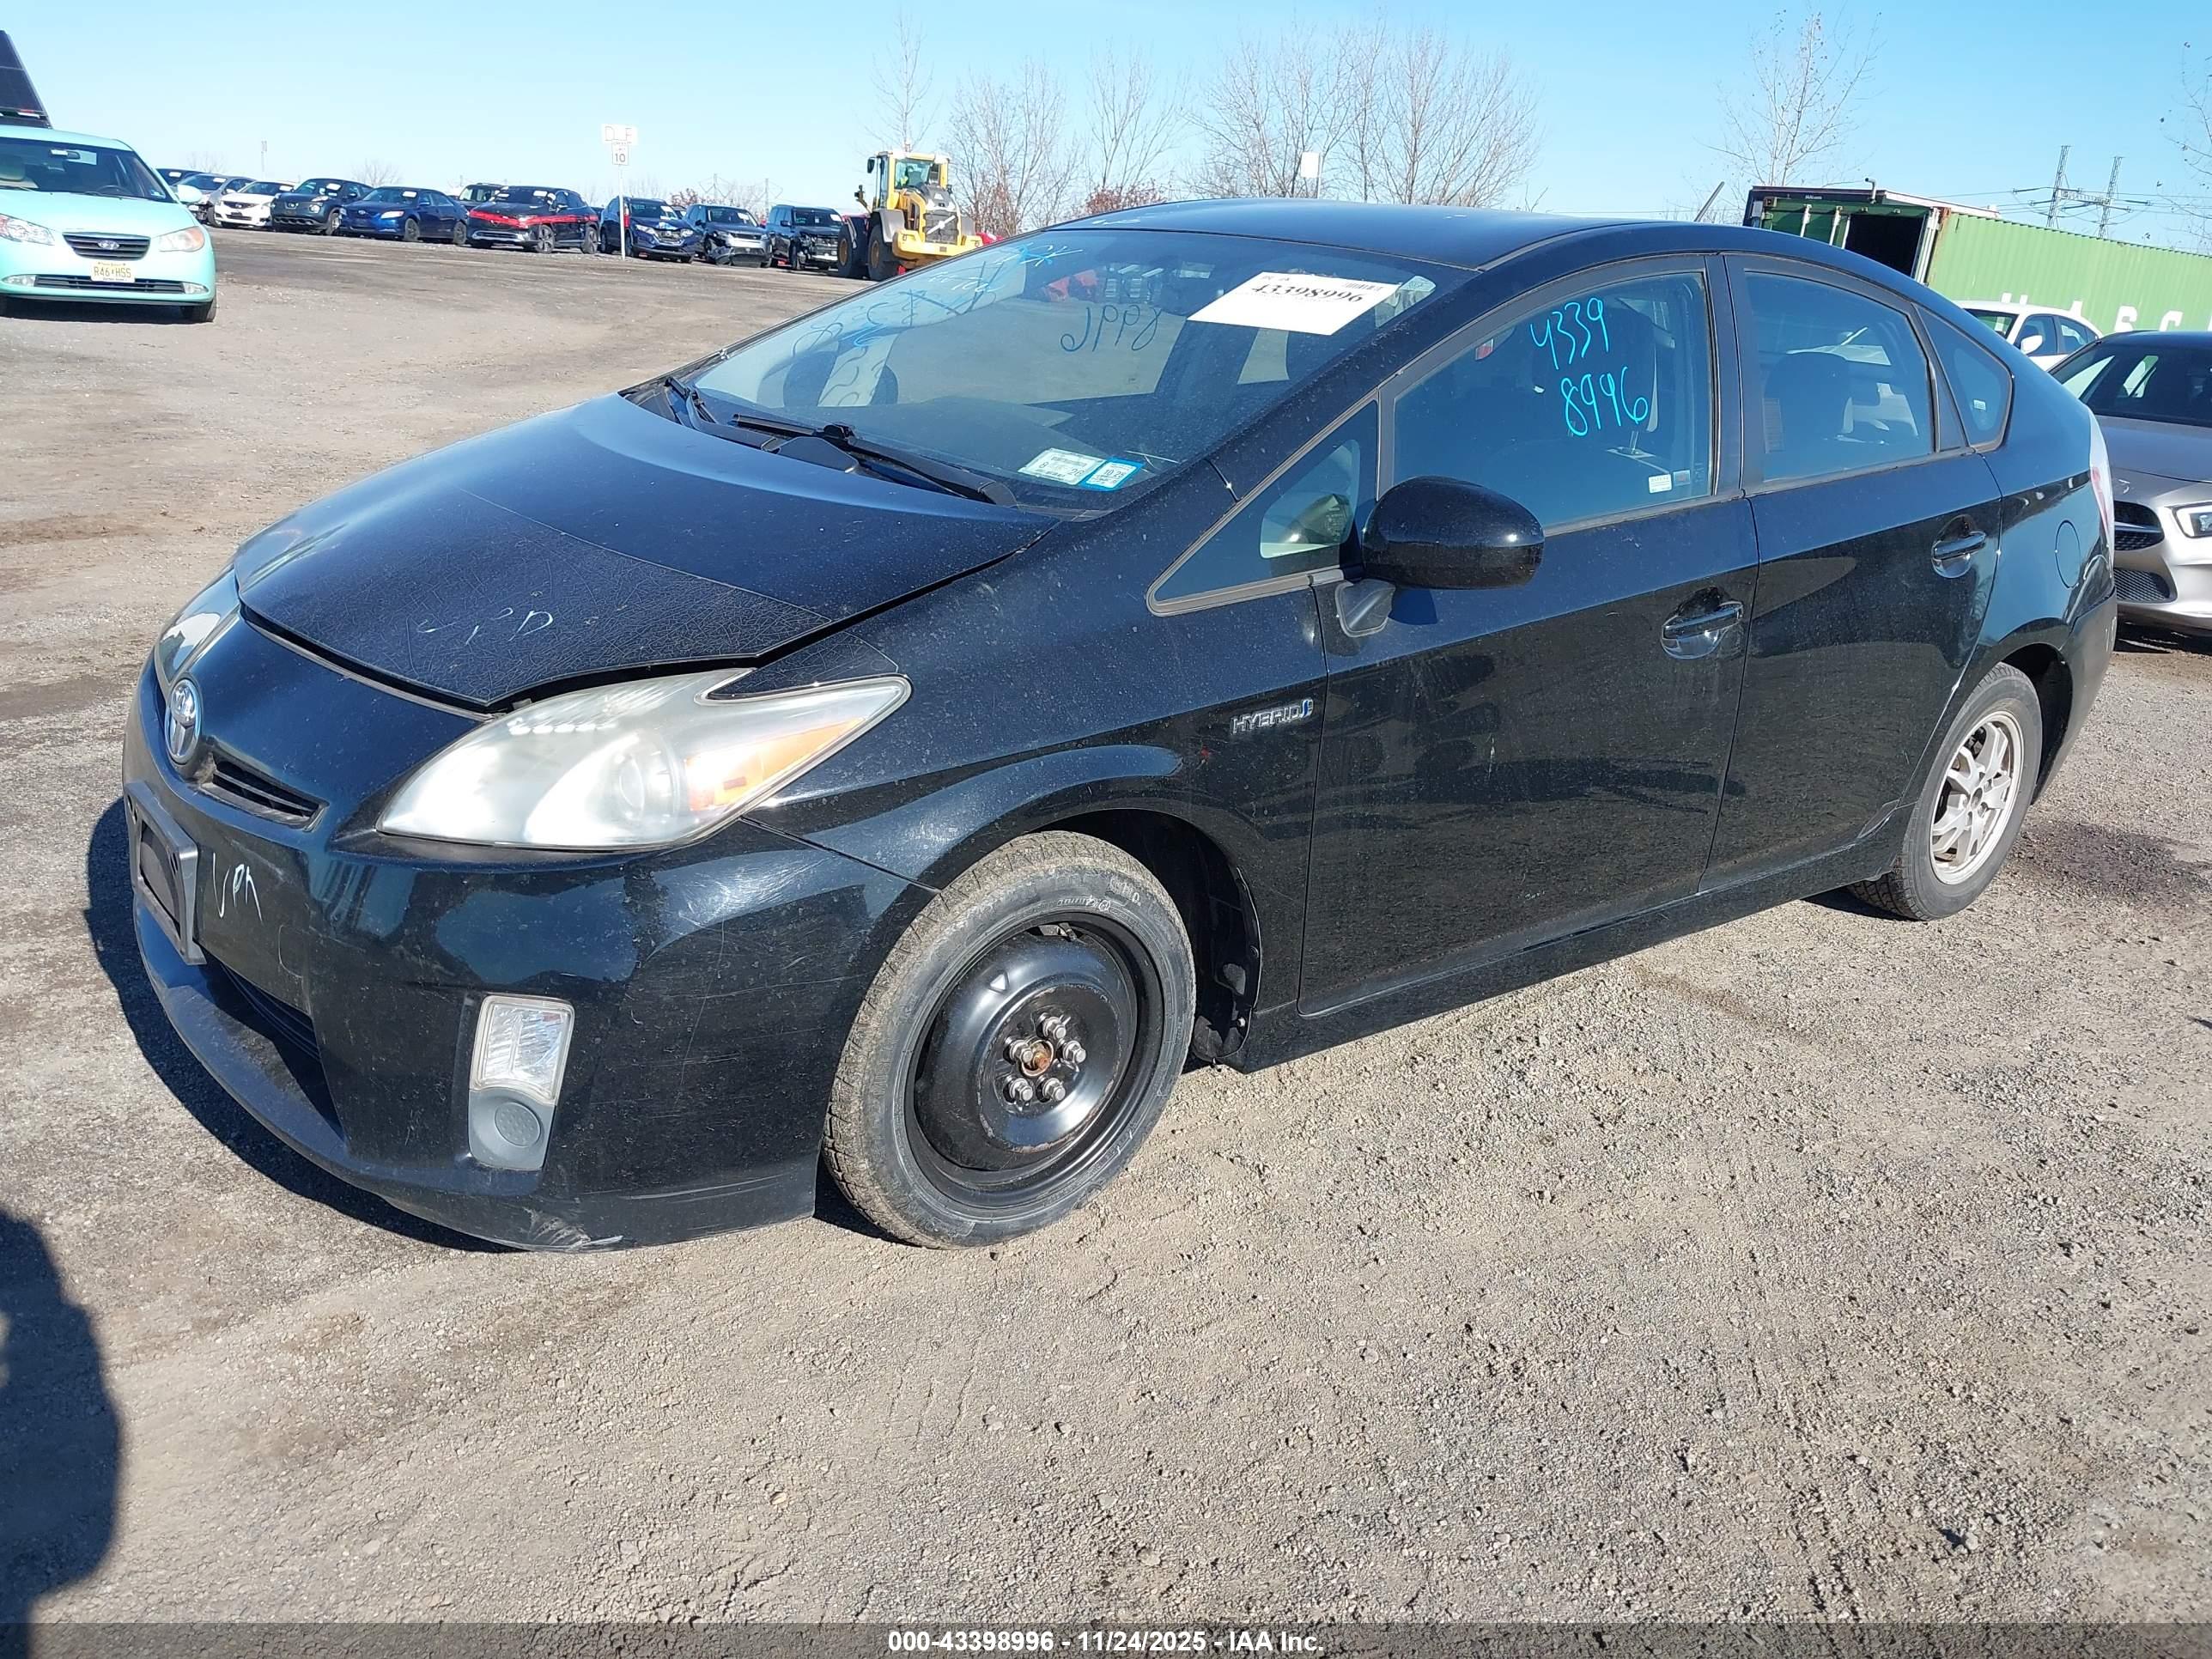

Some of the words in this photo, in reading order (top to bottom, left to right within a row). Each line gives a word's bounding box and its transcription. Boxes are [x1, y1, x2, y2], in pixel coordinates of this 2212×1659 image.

[615, 153, 626, 163] 10
[1251, 283, 1364, 302] 43398996
[1529, 297, 1609, 370] 4339
[1231, 704, 1300, 735] HYBRID
